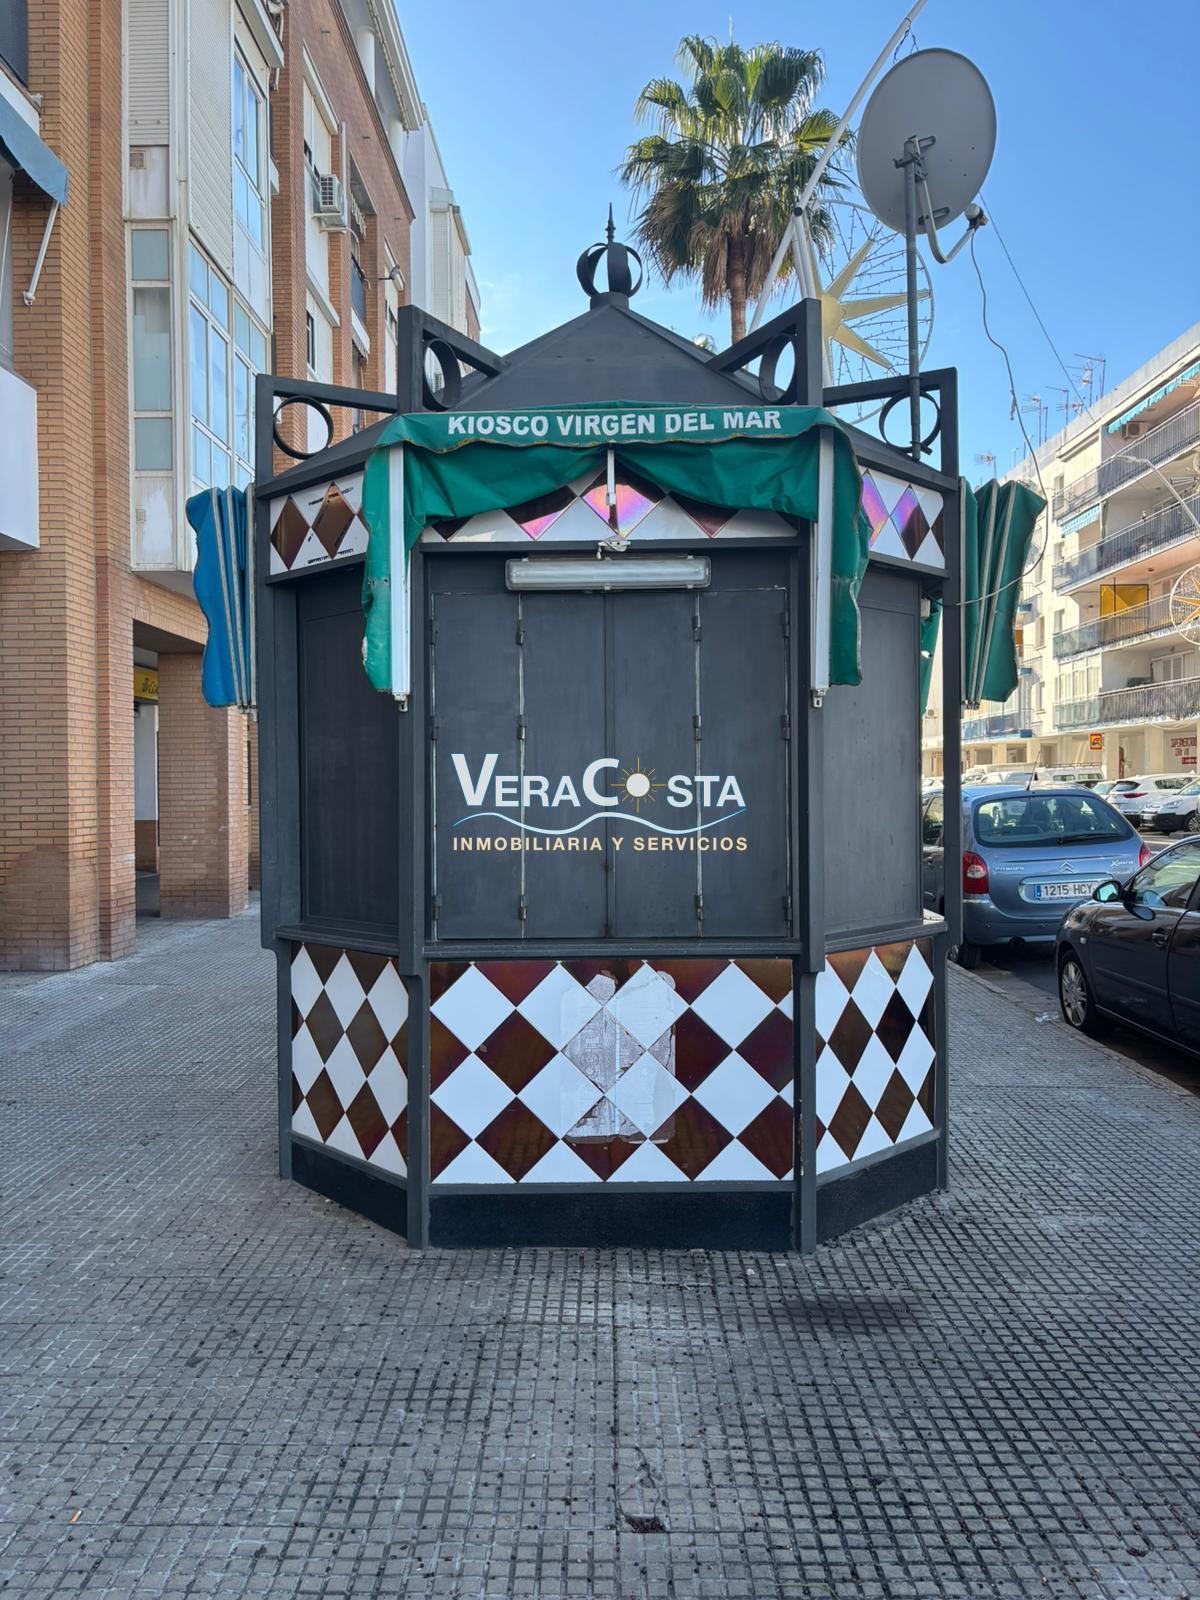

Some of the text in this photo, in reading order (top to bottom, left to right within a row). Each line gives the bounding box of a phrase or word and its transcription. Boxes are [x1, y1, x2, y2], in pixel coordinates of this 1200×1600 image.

[448, 410, 782, 437] KIOSCO VIRGEN DEL MAR
[453, 836, 748, 851] INMOBILIARIA Y SERVICIOS
[1044, 883, 1093, 896] 1215 HCY
